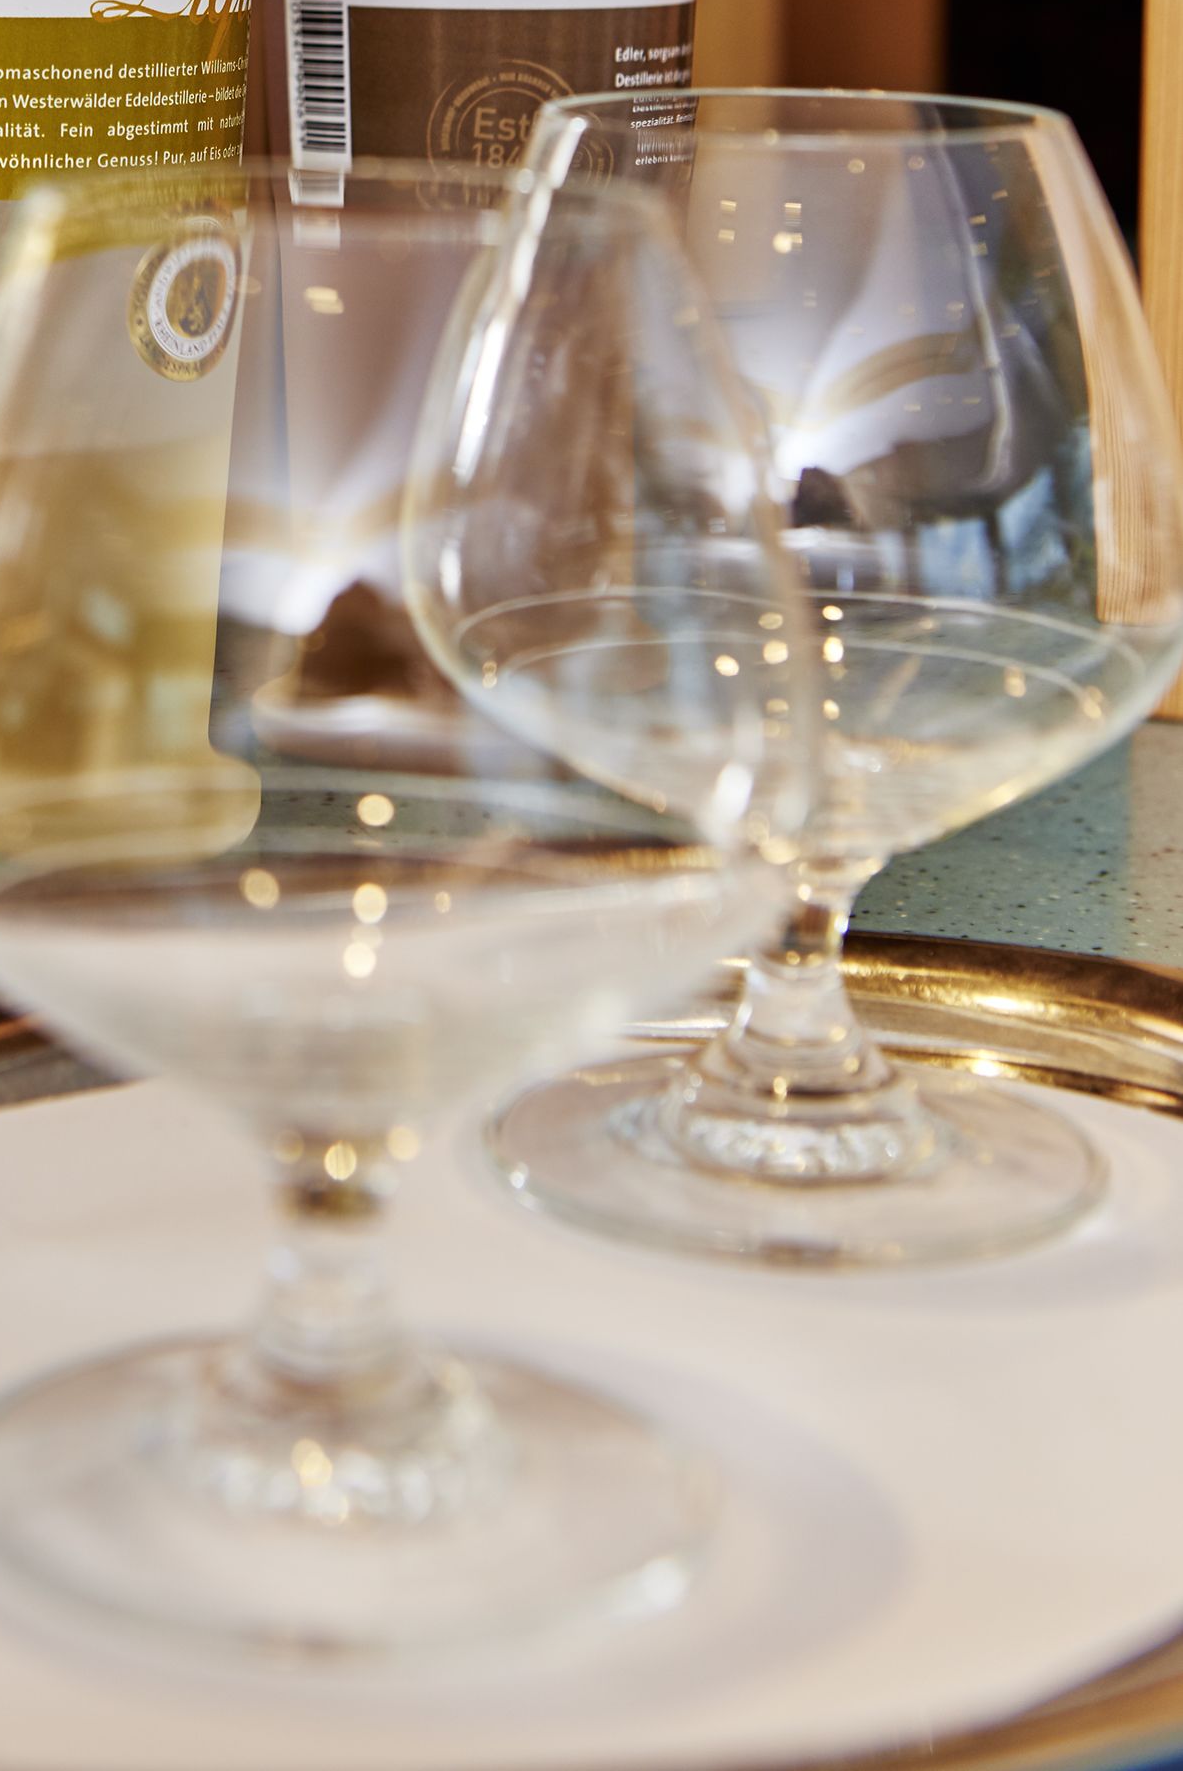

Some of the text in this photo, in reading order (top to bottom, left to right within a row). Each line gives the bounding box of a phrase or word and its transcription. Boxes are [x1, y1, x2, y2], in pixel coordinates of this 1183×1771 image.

[615, 46, 646, 63] Edler,
[118, 63, 198, 79] destillierter
[12, 93, 122, 109] Westerwälder
[125, 89, 207, 108] Edeldestillerie
[60, 123, 93, 138] Fein
[107, 119, 188, 141] abgestimmt
[197, 116, 214, 132] mit
[97, 150, 159, 168] Genuss!
[163, 150, 186, 166] Pur,
[190, 146, 207, 164] auf
[209, 146, 222, 161] Eis
